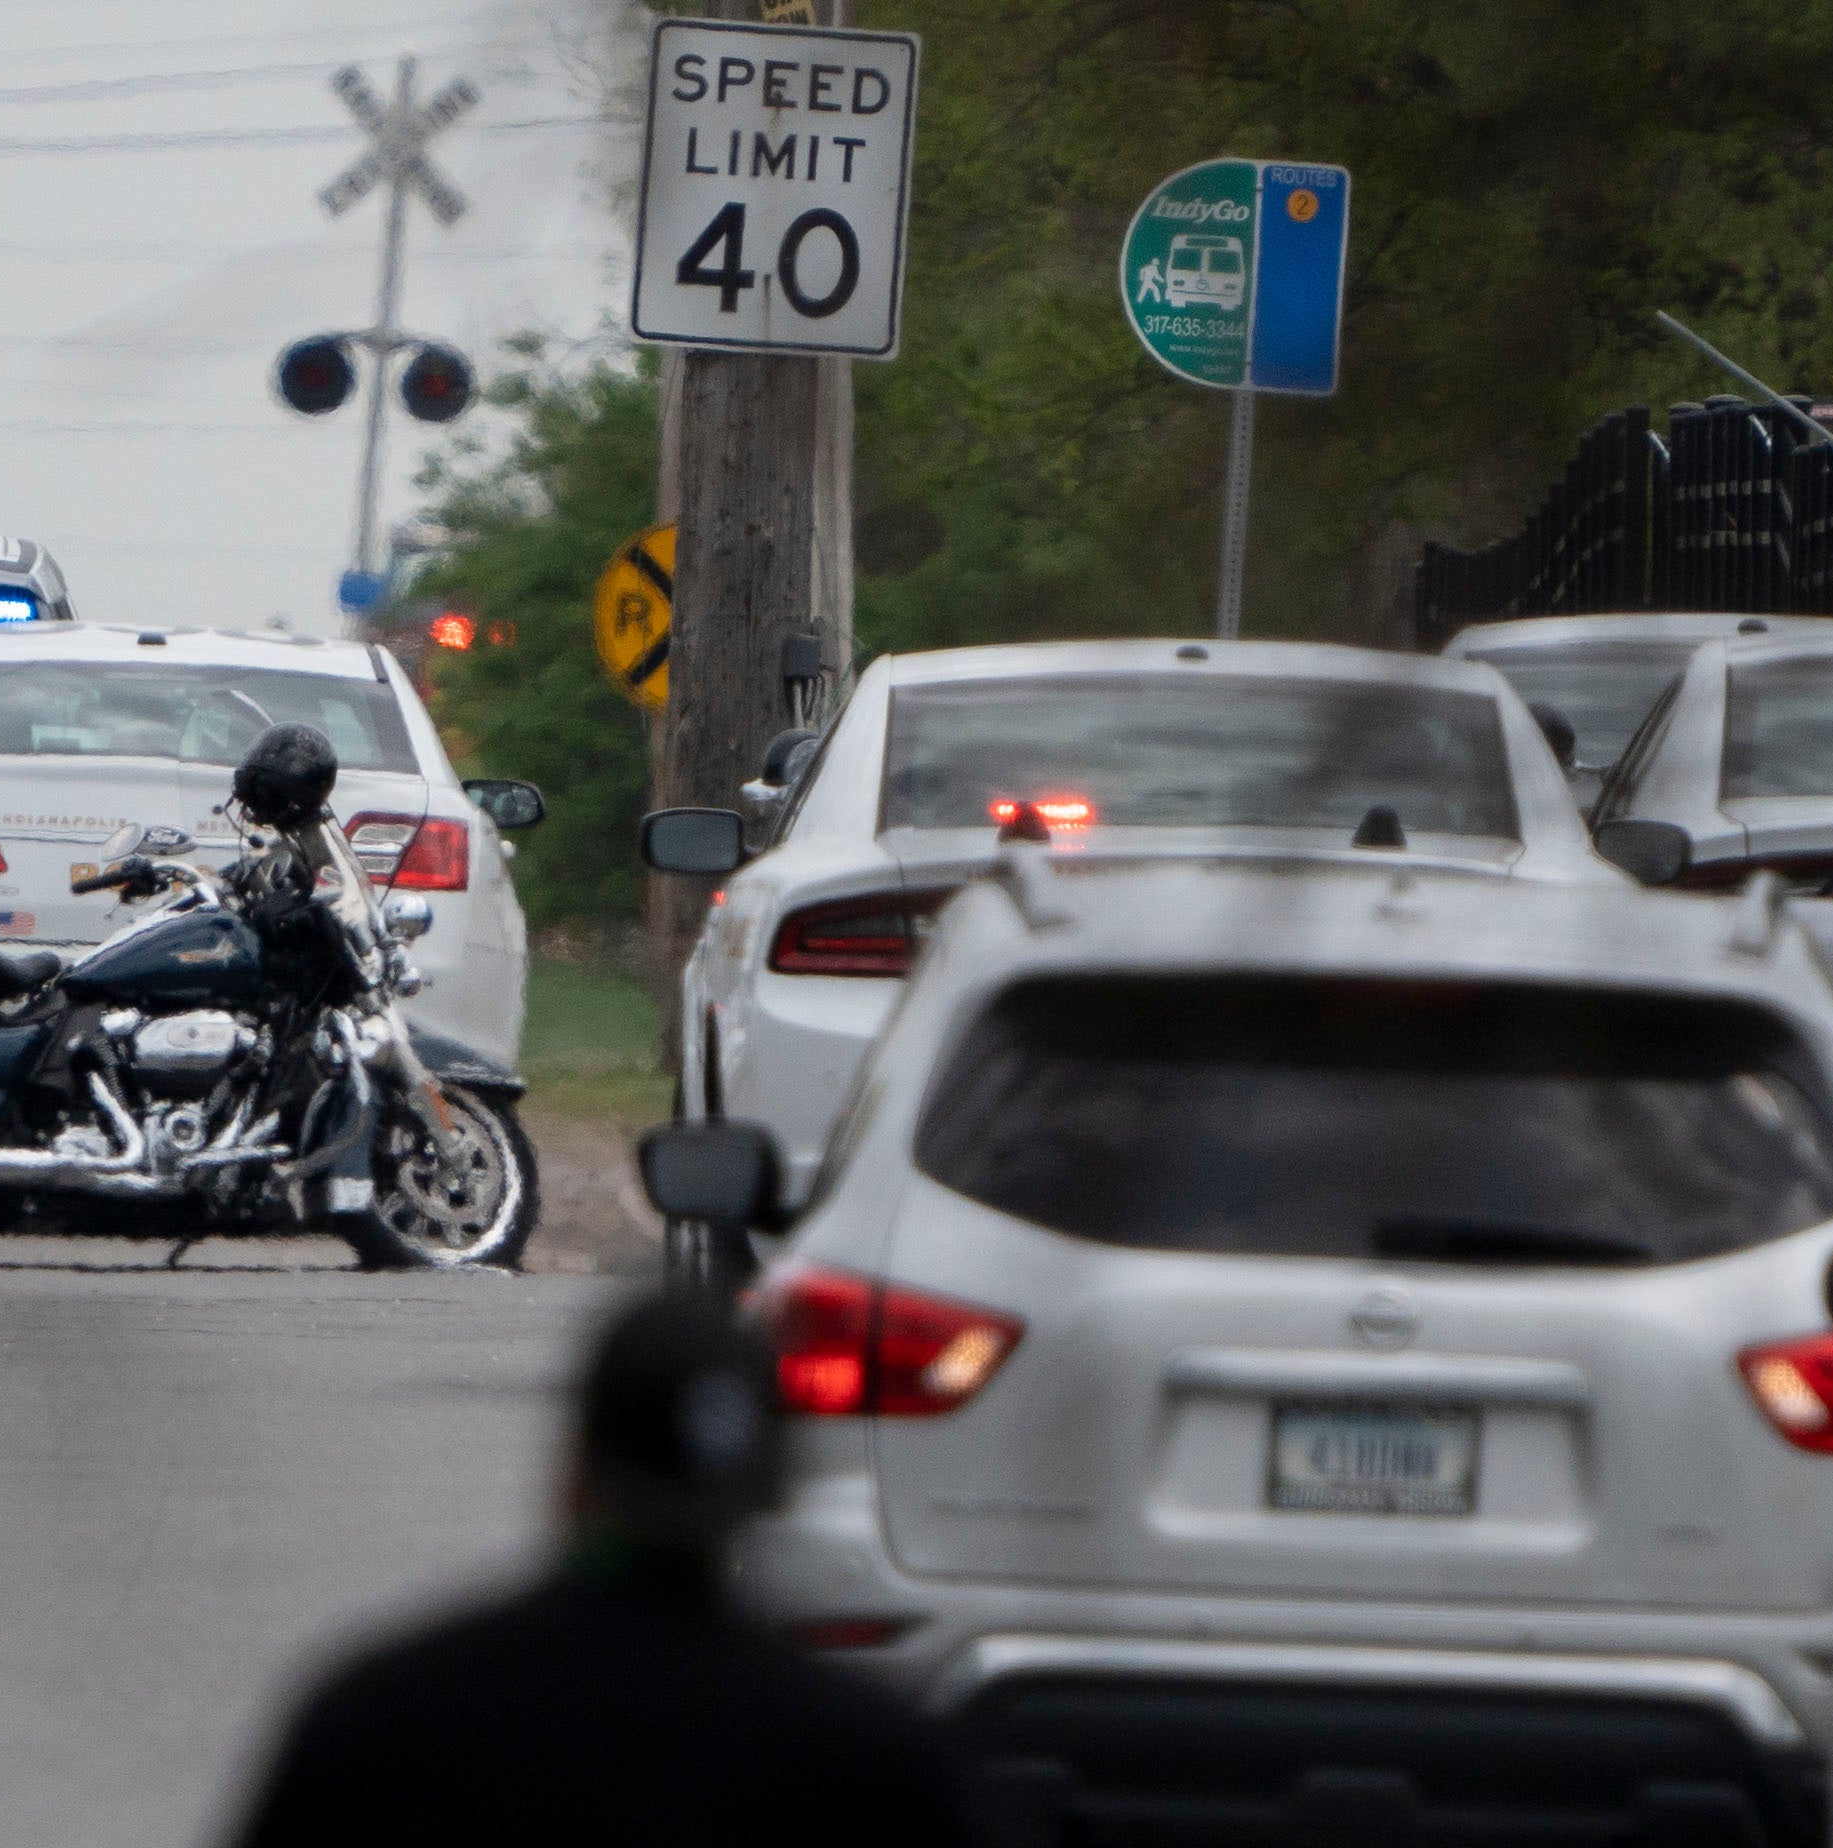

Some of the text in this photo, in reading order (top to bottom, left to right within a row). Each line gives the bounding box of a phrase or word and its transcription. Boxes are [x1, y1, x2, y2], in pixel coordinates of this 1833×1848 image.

[672, 53, 890, 115] SPEED
[686, 127, 866, 182] LIMIT
[1271, 167, 1337, 188] ROUTES
[1151, 196, 1249, 223] IndyGo
[1297, 195, 1309, 216] 2
[677, 202, 860, 319] 40
[616, 592, 651, 641] R
[147, 828, 179, 844] Ford
